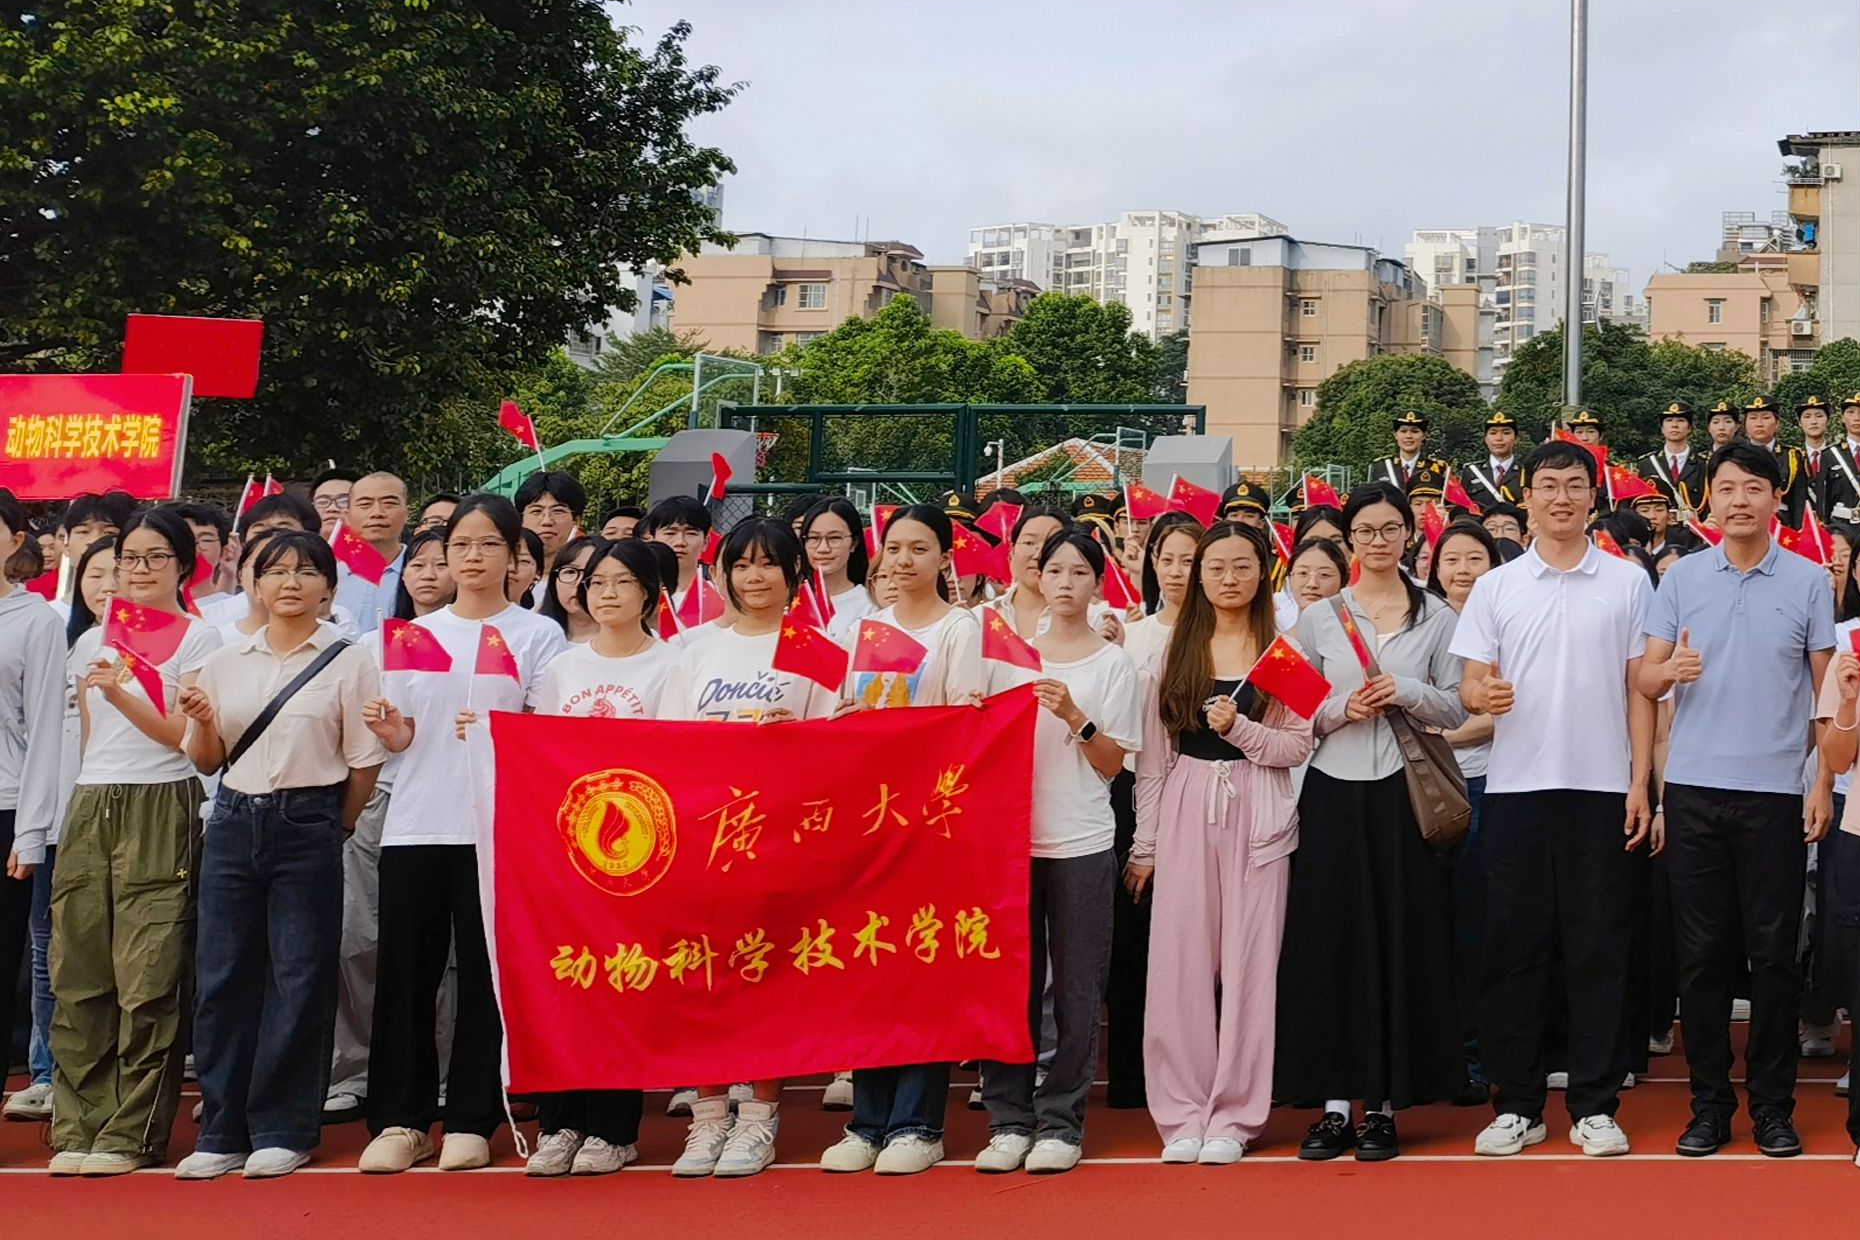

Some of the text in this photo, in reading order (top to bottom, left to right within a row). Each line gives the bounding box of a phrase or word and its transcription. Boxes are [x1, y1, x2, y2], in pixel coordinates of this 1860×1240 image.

[5, 414, 162, 459] 动物科学技术学院
[562, 684, 645, 716] BON APPÉTIT
[549, 902, 1001, 993] 动物科学技术学院
